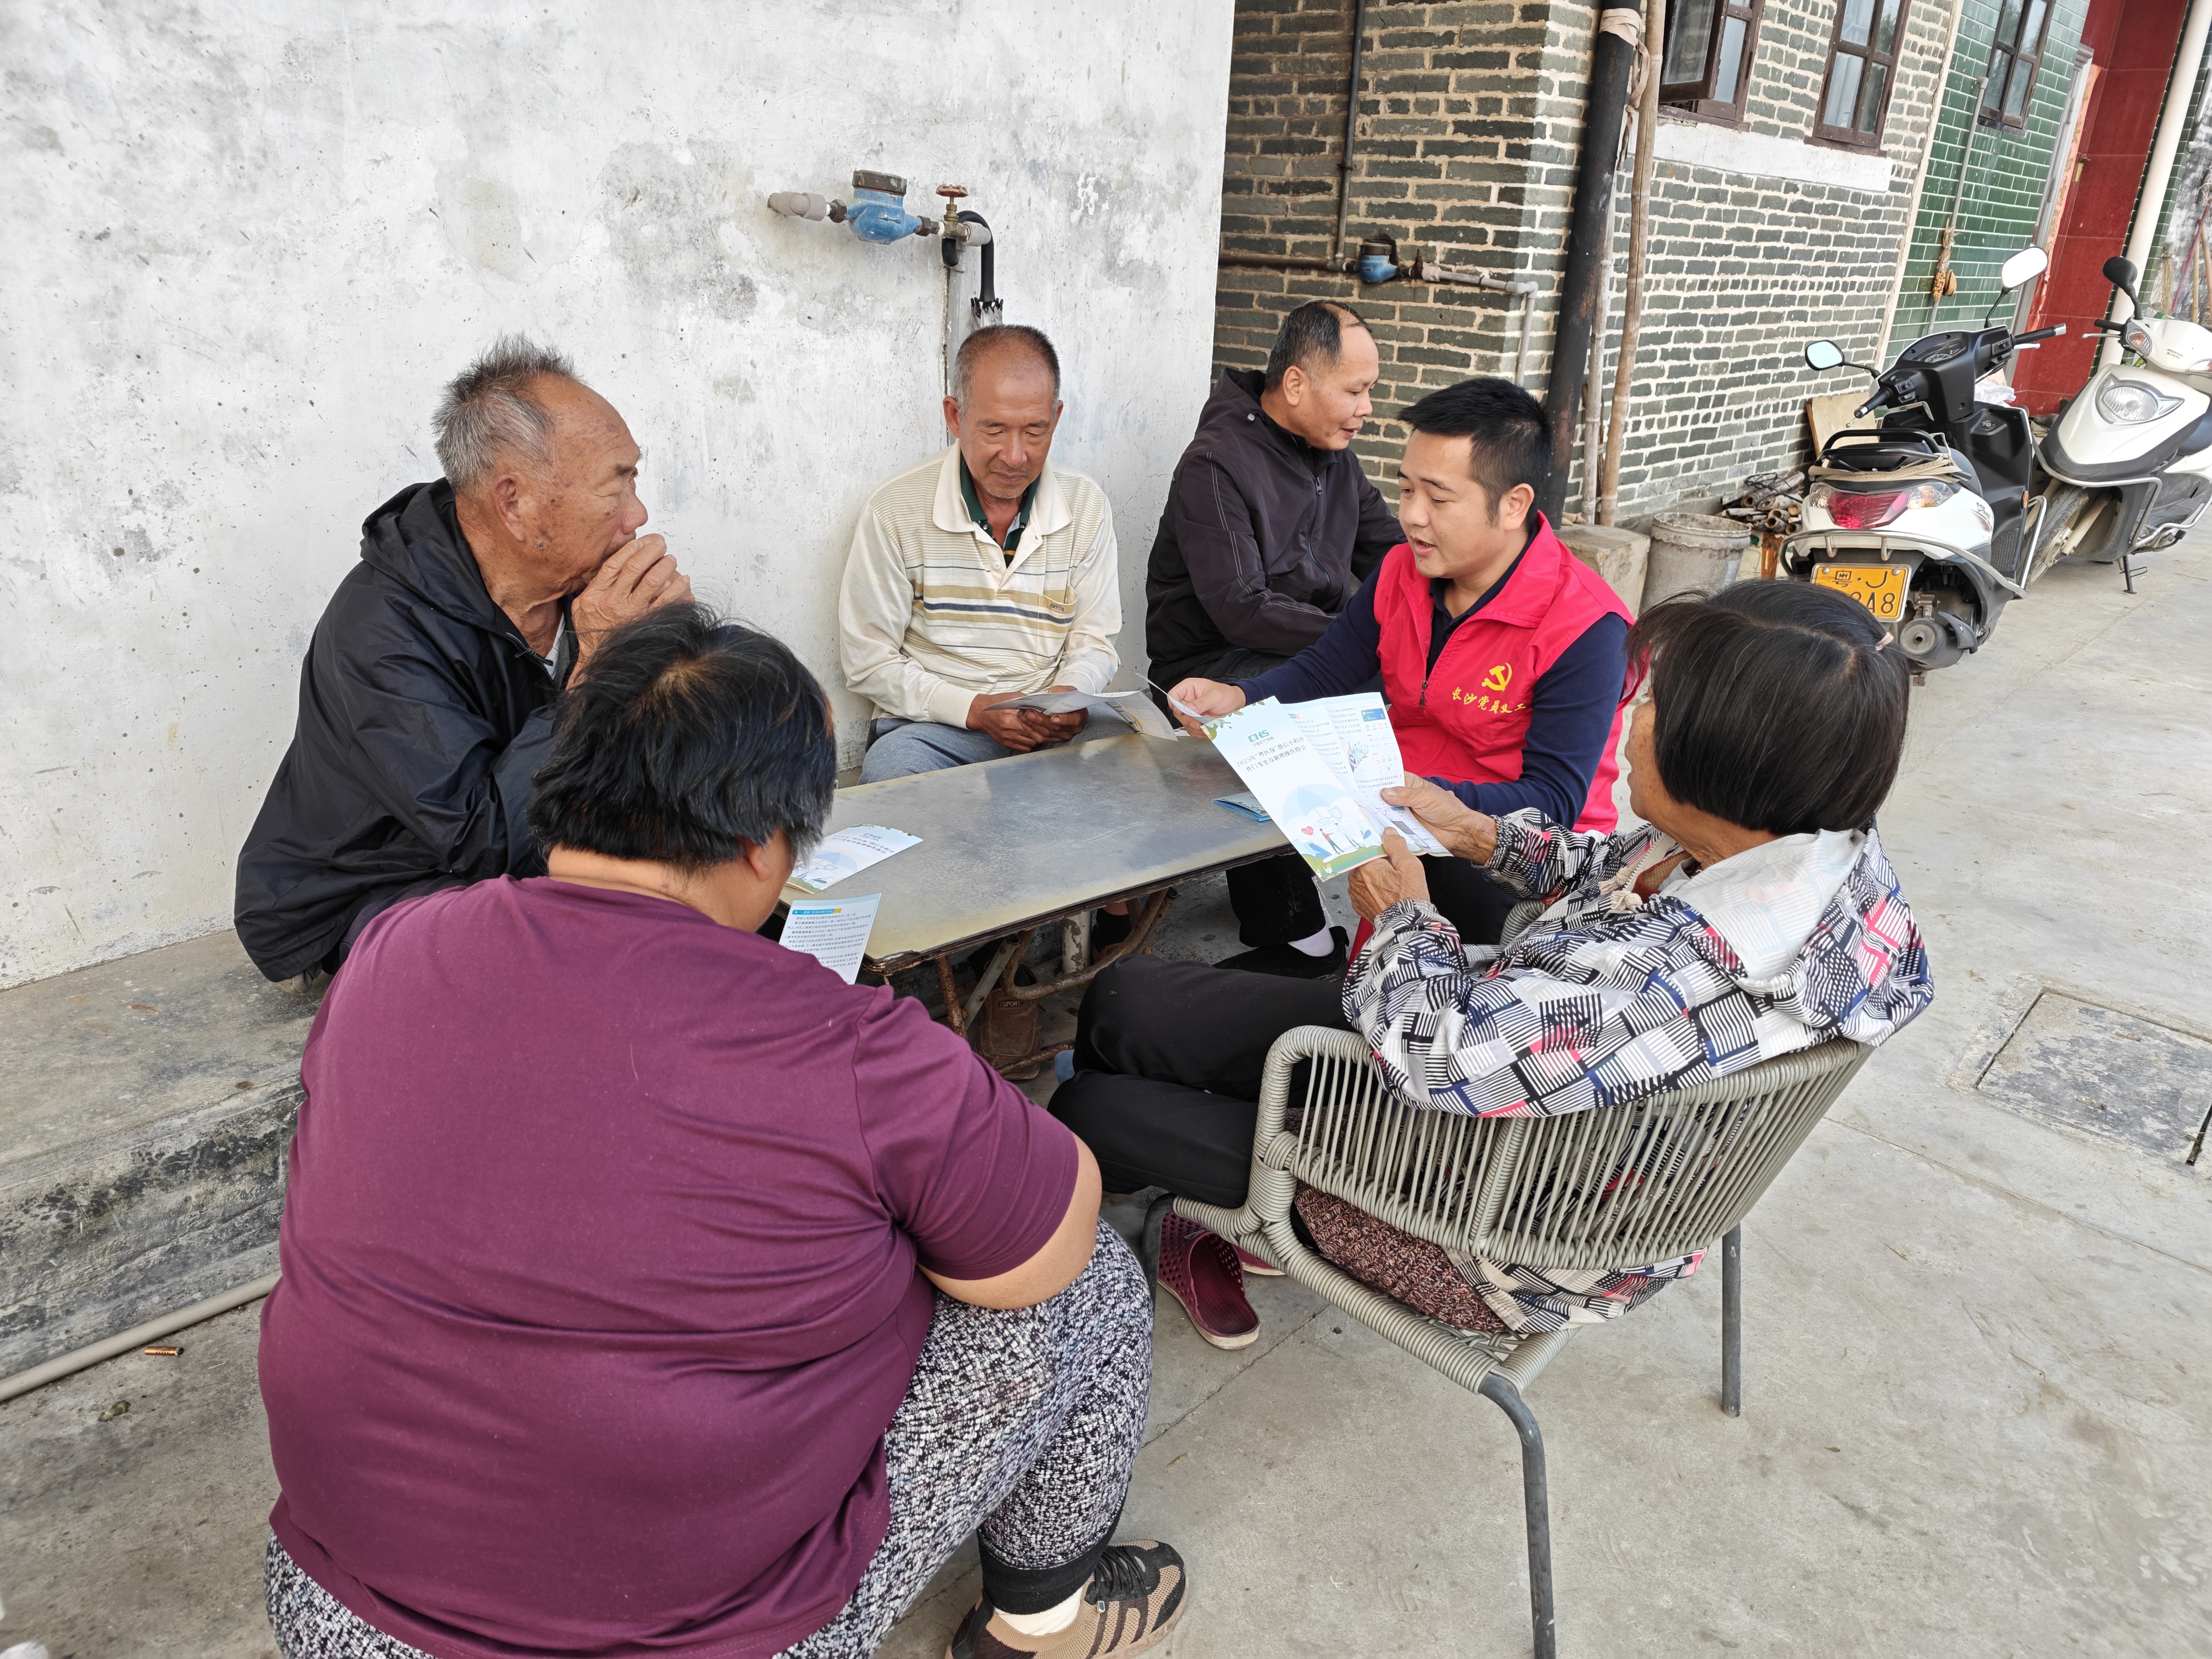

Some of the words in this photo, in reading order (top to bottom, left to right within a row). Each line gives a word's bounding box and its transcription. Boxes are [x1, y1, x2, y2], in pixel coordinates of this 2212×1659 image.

[2167, 348, 2183, 357] HONDA
[1452, 686, 1526, 714] 长沙党员义工
[1247, 729, 1270, 743] CHS
[1252, 736, 1274, 747] 中国医疗保障
